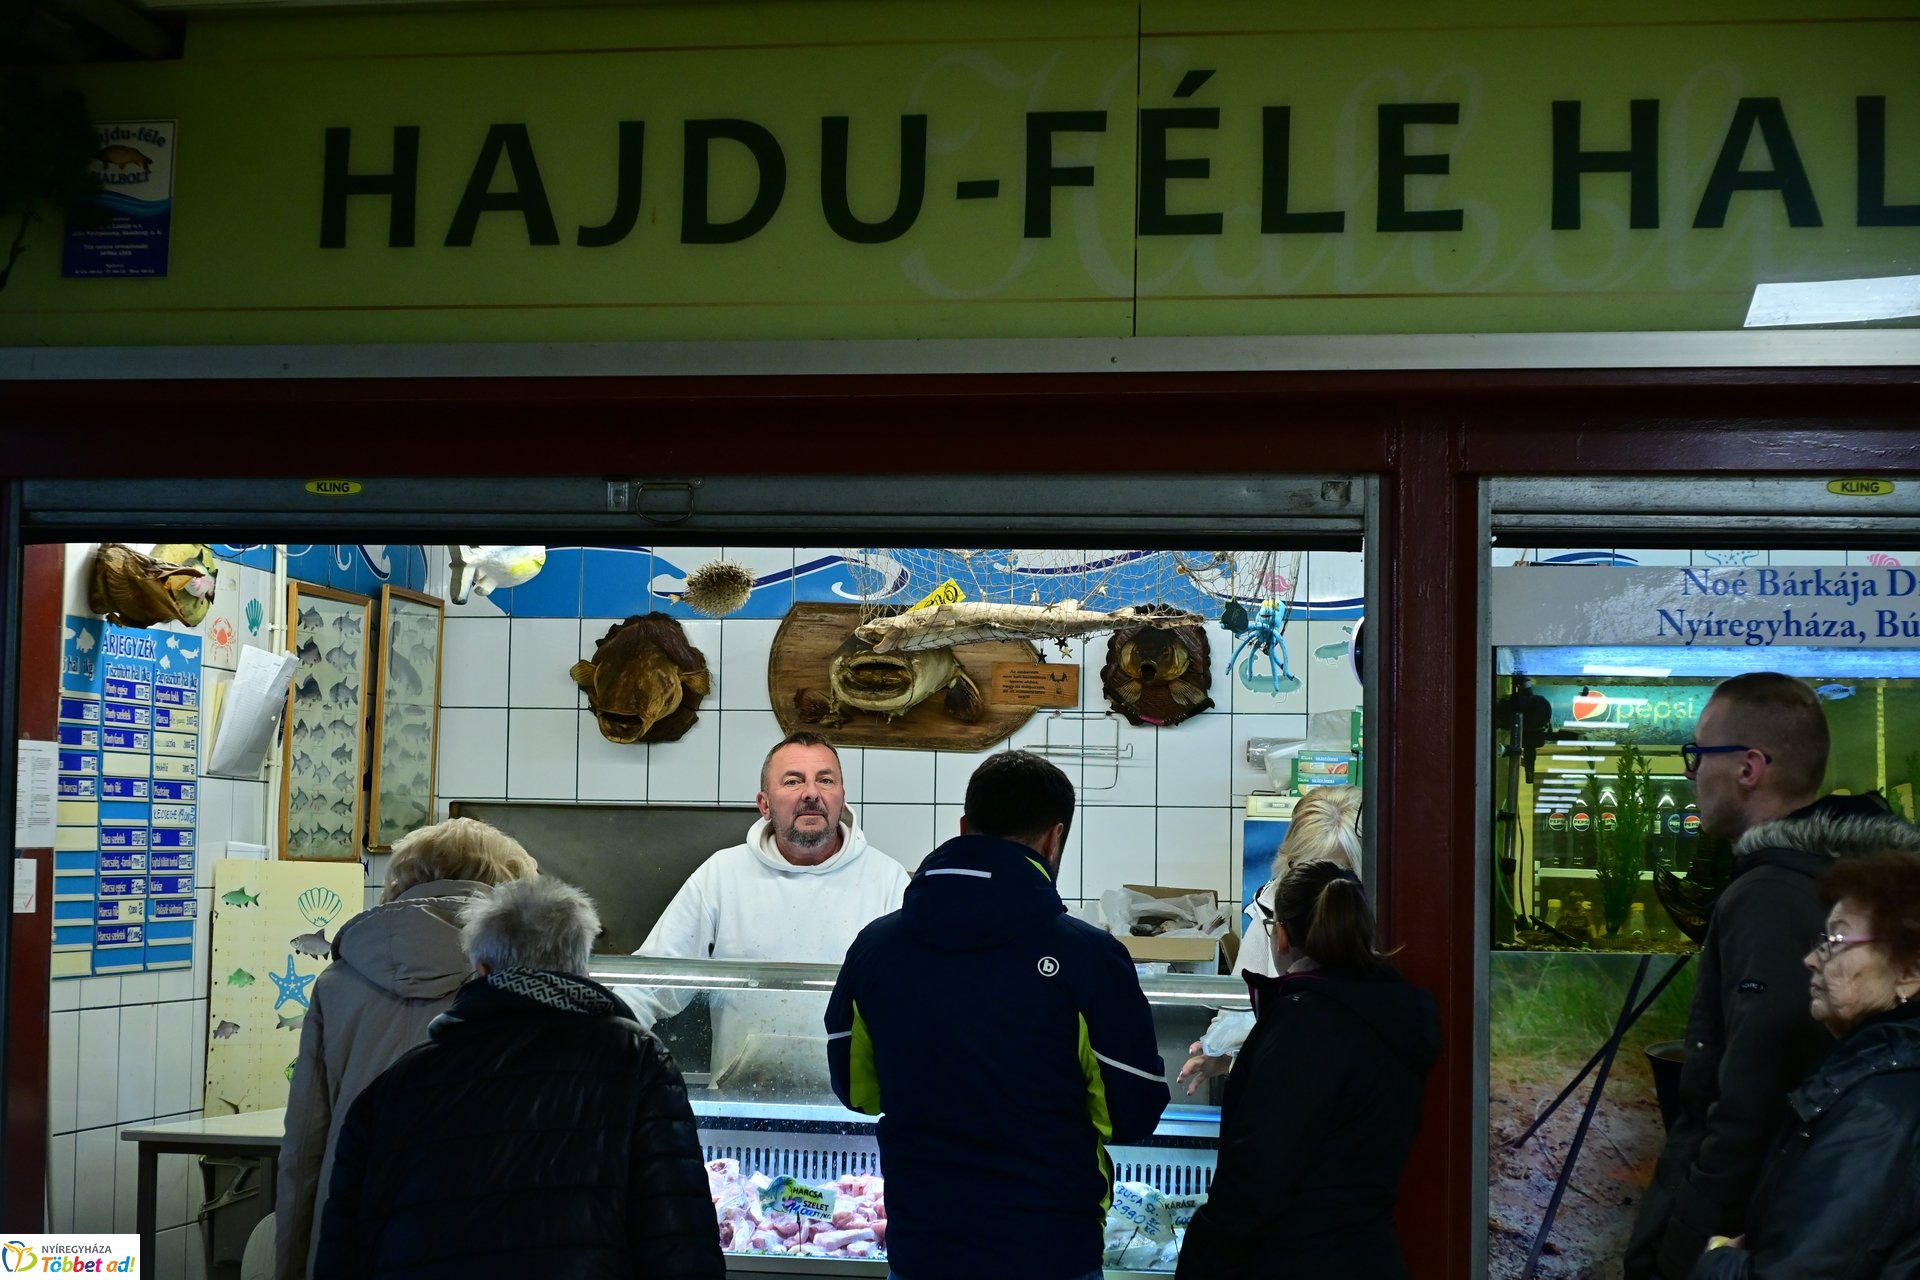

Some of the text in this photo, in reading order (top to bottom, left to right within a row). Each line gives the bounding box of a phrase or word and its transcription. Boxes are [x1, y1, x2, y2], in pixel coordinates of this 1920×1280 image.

[321, 69, 1463, 249] HAJDU-FÉLE
[316, 482, 350, 493] KLING
[1841, 482, 1880, 493] KLING
[1681, 568, 1748, 597] Noé
[1757, 568, 1879, 606] Bárkája
[1657, 609, 1866, 646] Nyíregyháza,
[102, 629, 157, 662] ÁRJEGYZÉK
[1617, 697, 1694, 723] pepsi
[792, 1186, 824, 1200] HARCSA
[802, 1200, 830, 1212] SZELET
[1164, 1199, 1197, 1211] KÁRÁSZ
